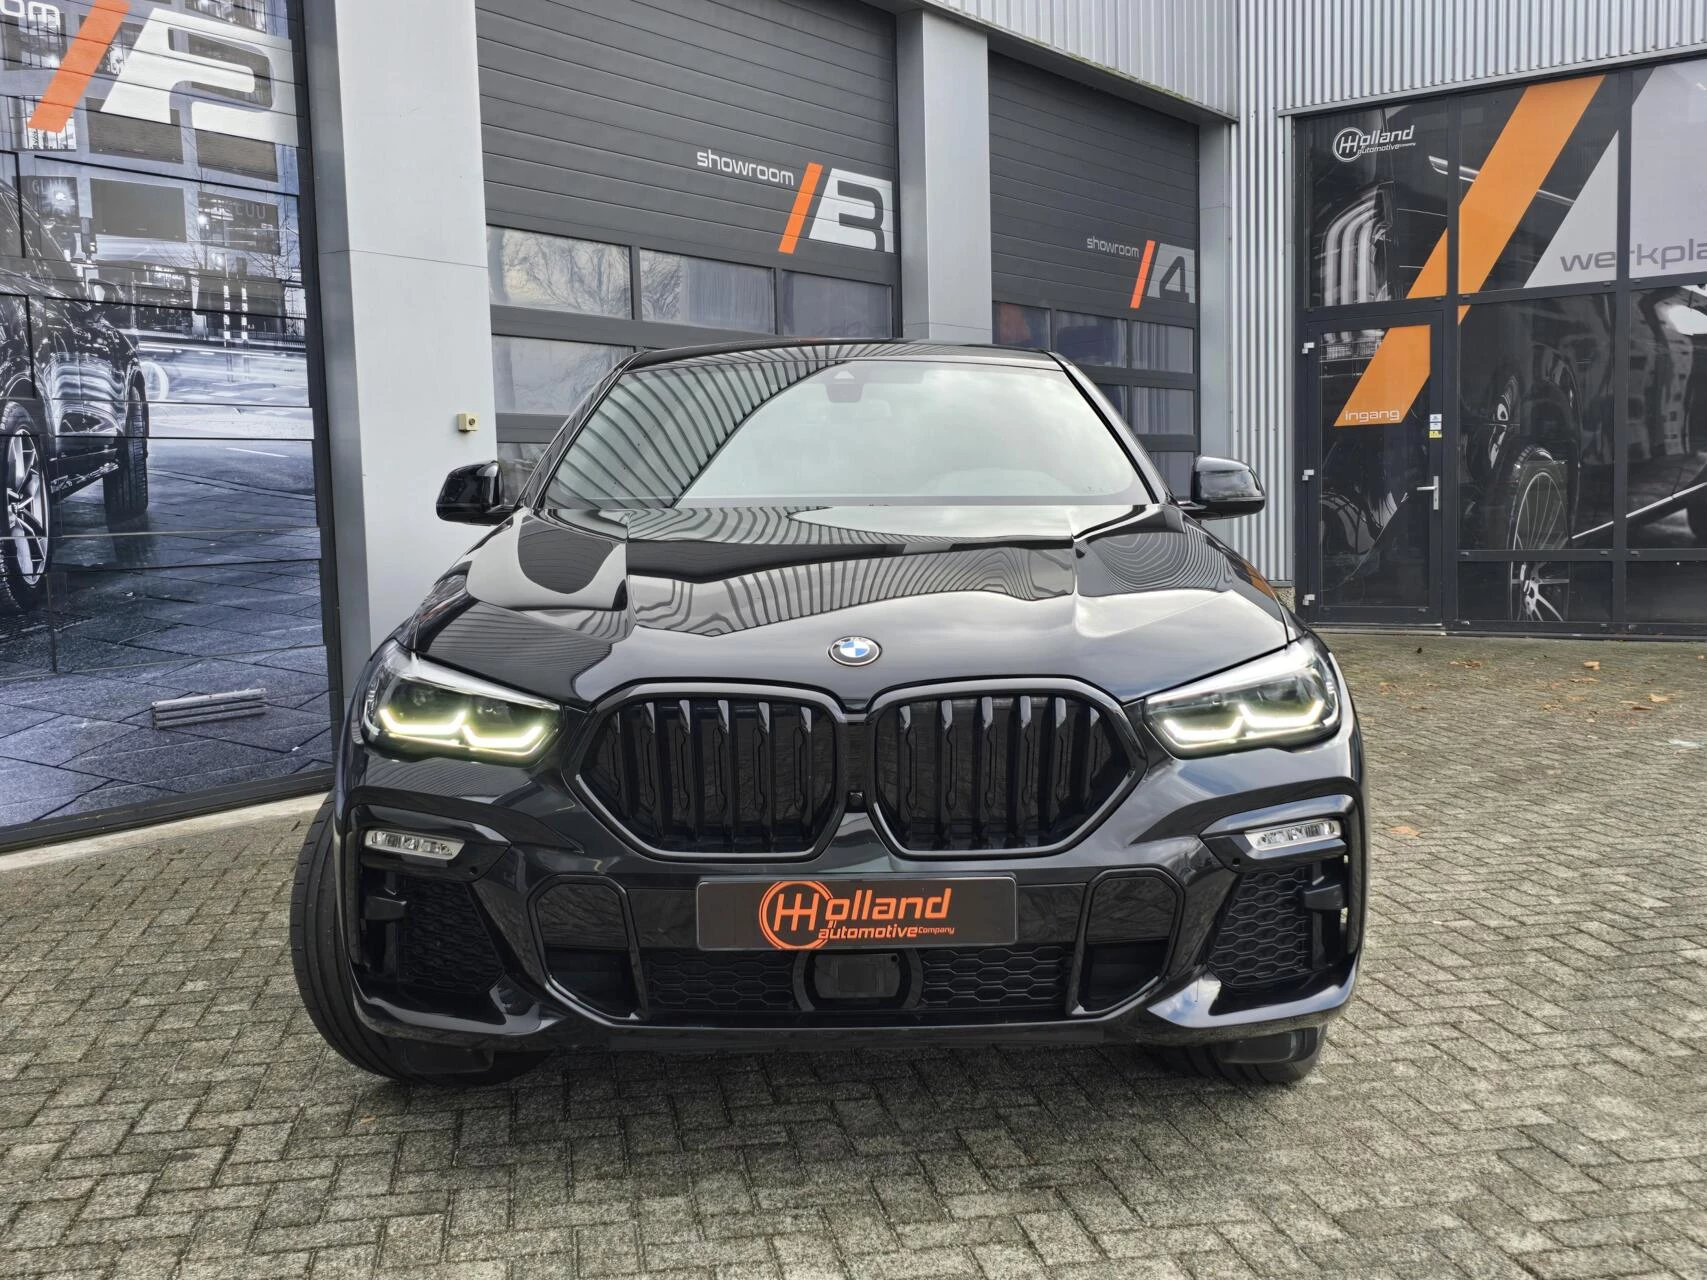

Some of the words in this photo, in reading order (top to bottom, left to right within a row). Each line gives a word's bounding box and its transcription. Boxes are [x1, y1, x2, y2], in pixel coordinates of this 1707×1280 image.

[696, 149, 794, 186] showroom
[1086, 236, 1140, 258] showroom
[1560, 238, 1707, 272] wekpl
[1345, 410, 1400, 423] ingang
[818, 924, 918, 939] automotive
[918, 926, 955, 935] Company
